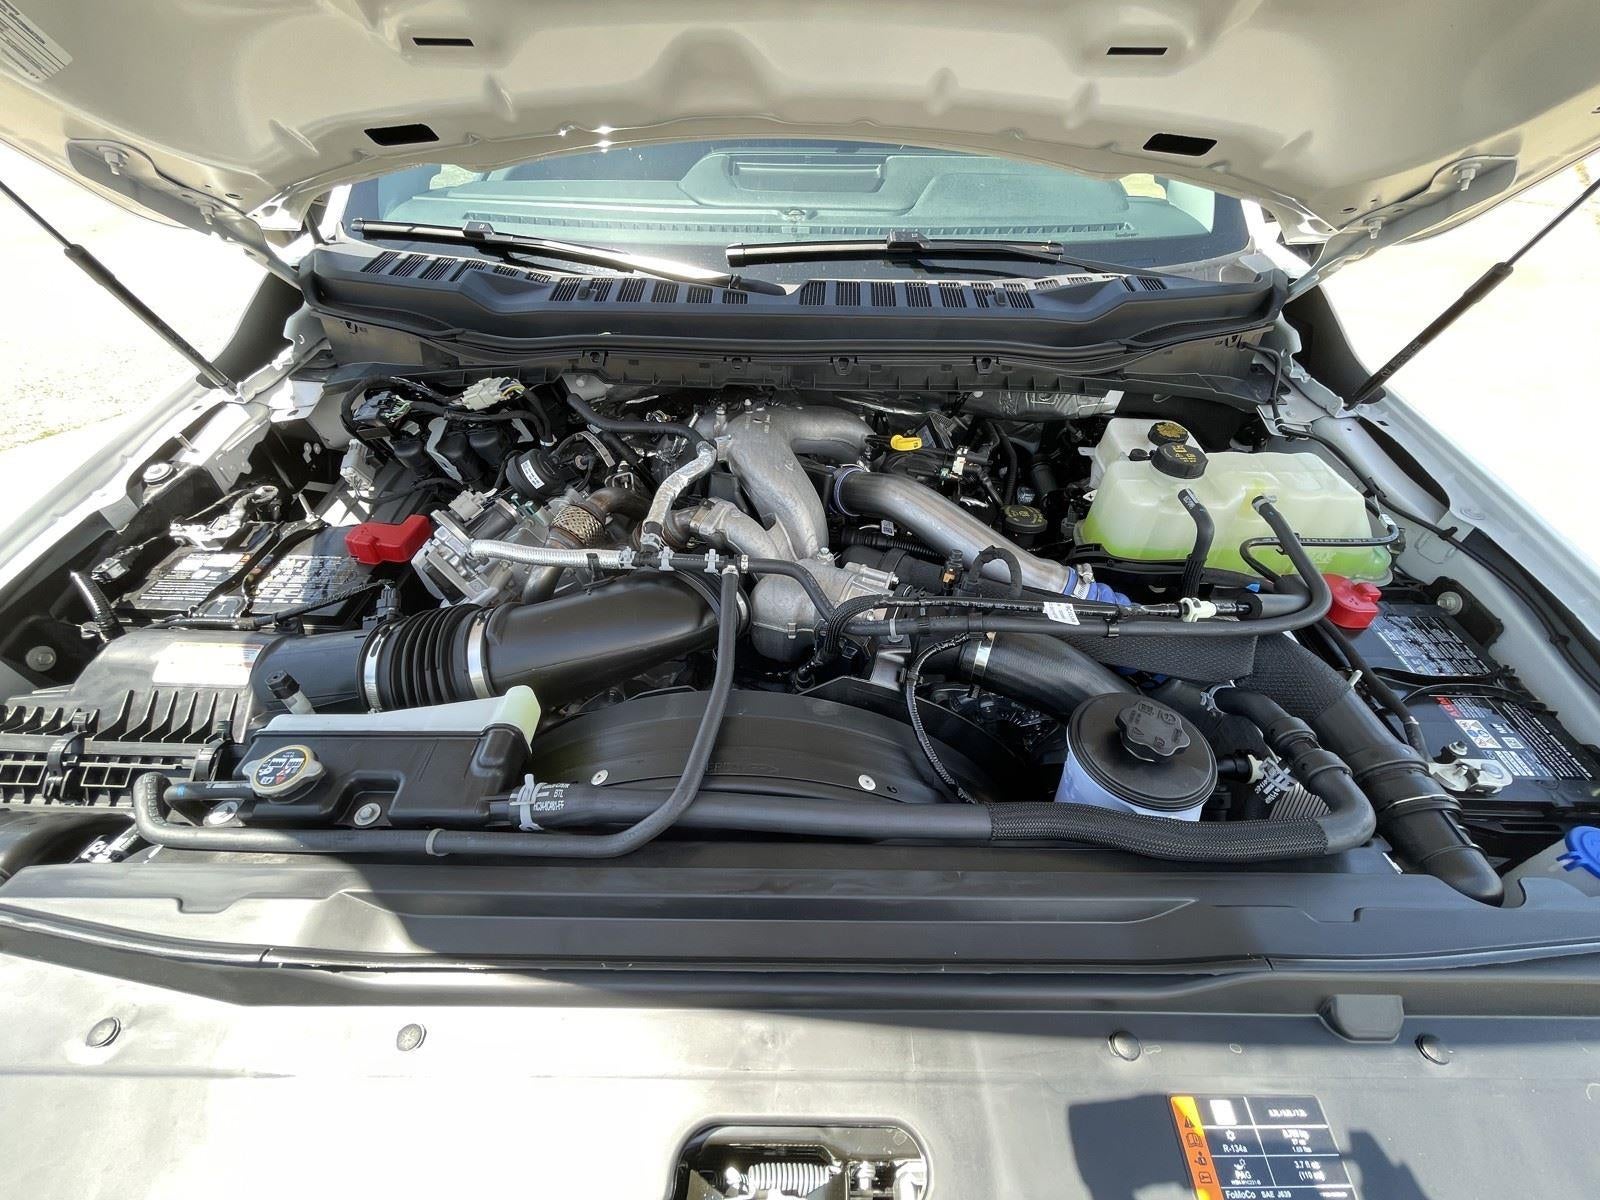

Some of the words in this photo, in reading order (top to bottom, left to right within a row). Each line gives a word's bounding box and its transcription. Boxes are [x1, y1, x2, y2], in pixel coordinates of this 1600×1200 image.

[1234, 1170, 1252, 1180] PAG
[1225, 1190, 1257, 1199] FoMoCo
[1260, 1190, 1276, 1199] SAE
